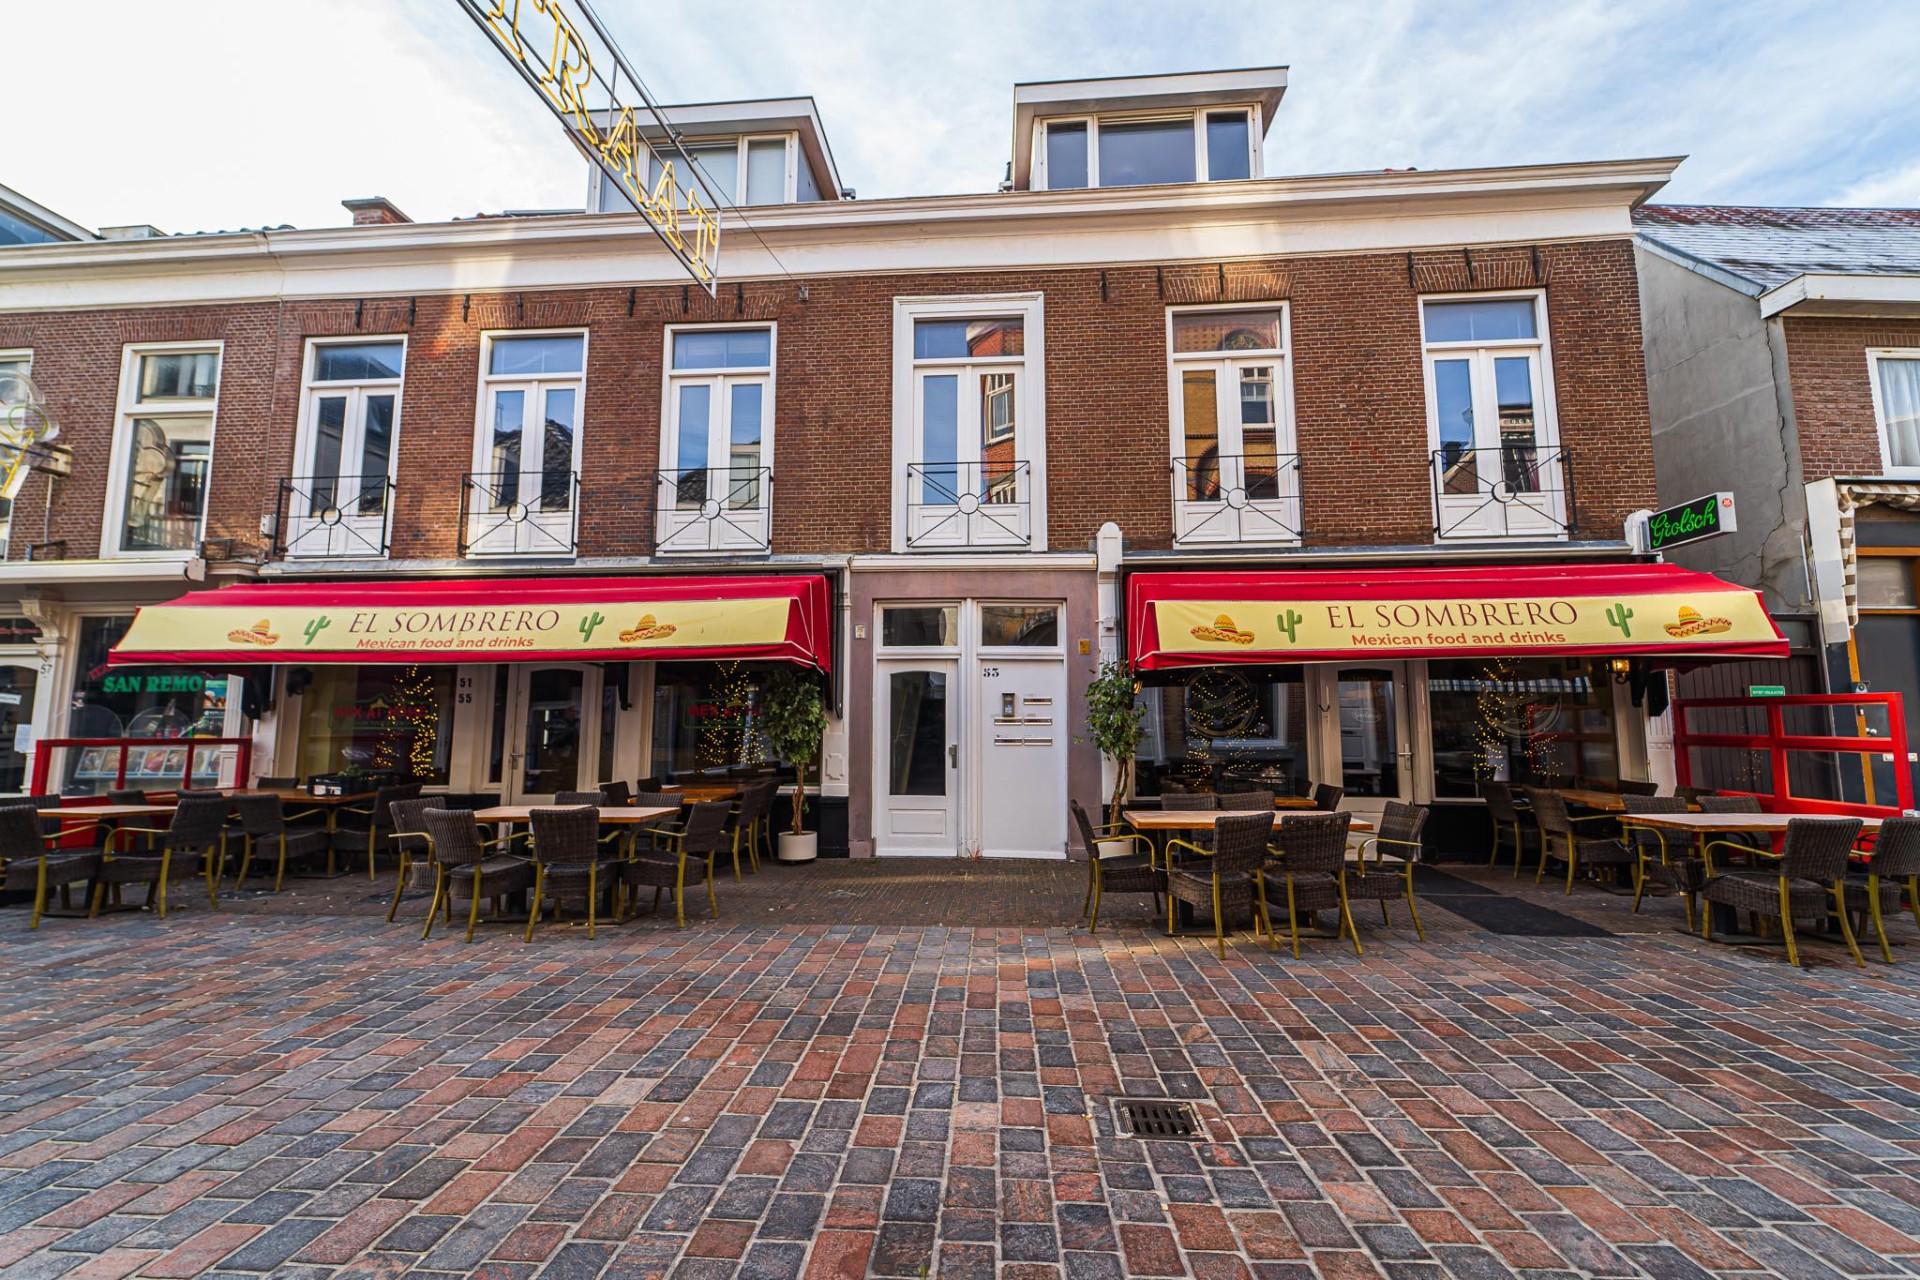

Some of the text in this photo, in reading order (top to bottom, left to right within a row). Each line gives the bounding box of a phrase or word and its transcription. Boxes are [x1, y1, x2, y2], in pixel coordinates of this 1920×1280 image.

[1650, 499, 1716, 547] Grolsch
[348, 609, 560, 633] EL SOMBRERO
[1326, 601, 1578, 628] EL SOMBRERO
[356, 636, 534, 649] Mexican food and drinks
[1351, 631, 1567, 646] Mexican food and drinks
[40, 663, 53, 675] 57
[102, 675, 203, 693] SAN REMO
[459, 677, 472, 688] 51
[458, 693, 472, 704] 55
